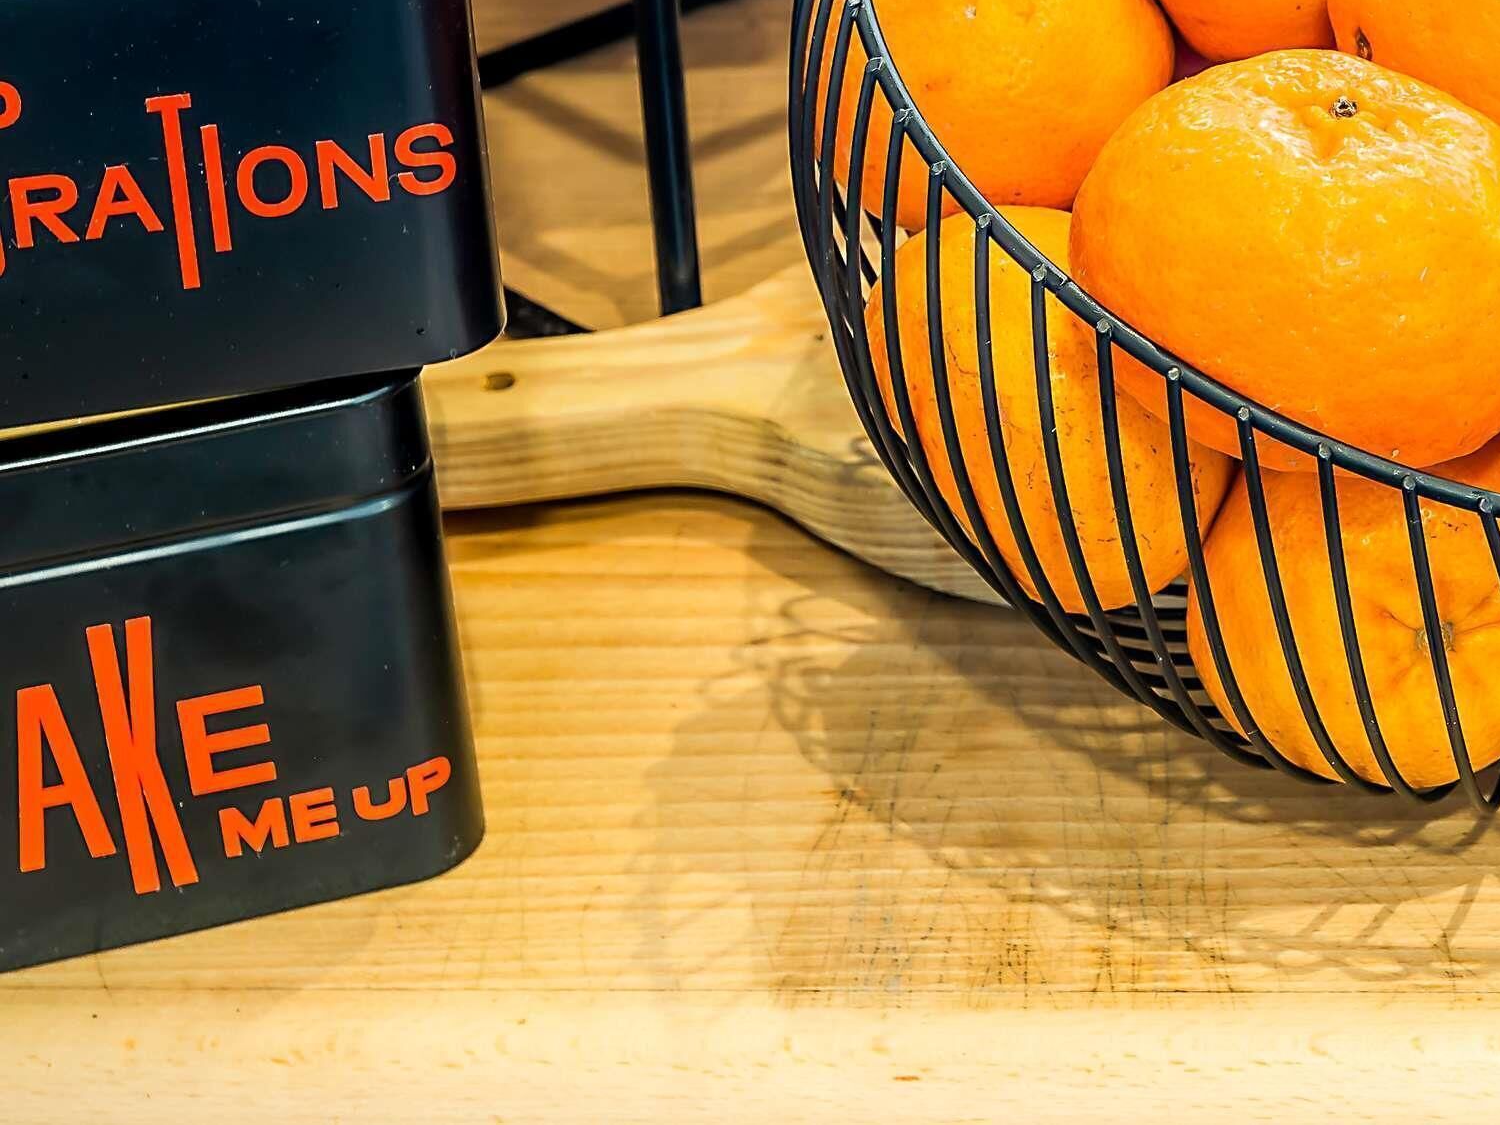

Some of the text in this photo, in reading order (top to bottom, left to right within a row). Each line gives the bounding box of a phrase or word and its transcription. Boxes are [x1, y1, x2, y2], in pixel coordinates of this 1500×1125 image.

[0, 92, 458, 290] RATIONS
[218, 755, 452, 859] ME UP
